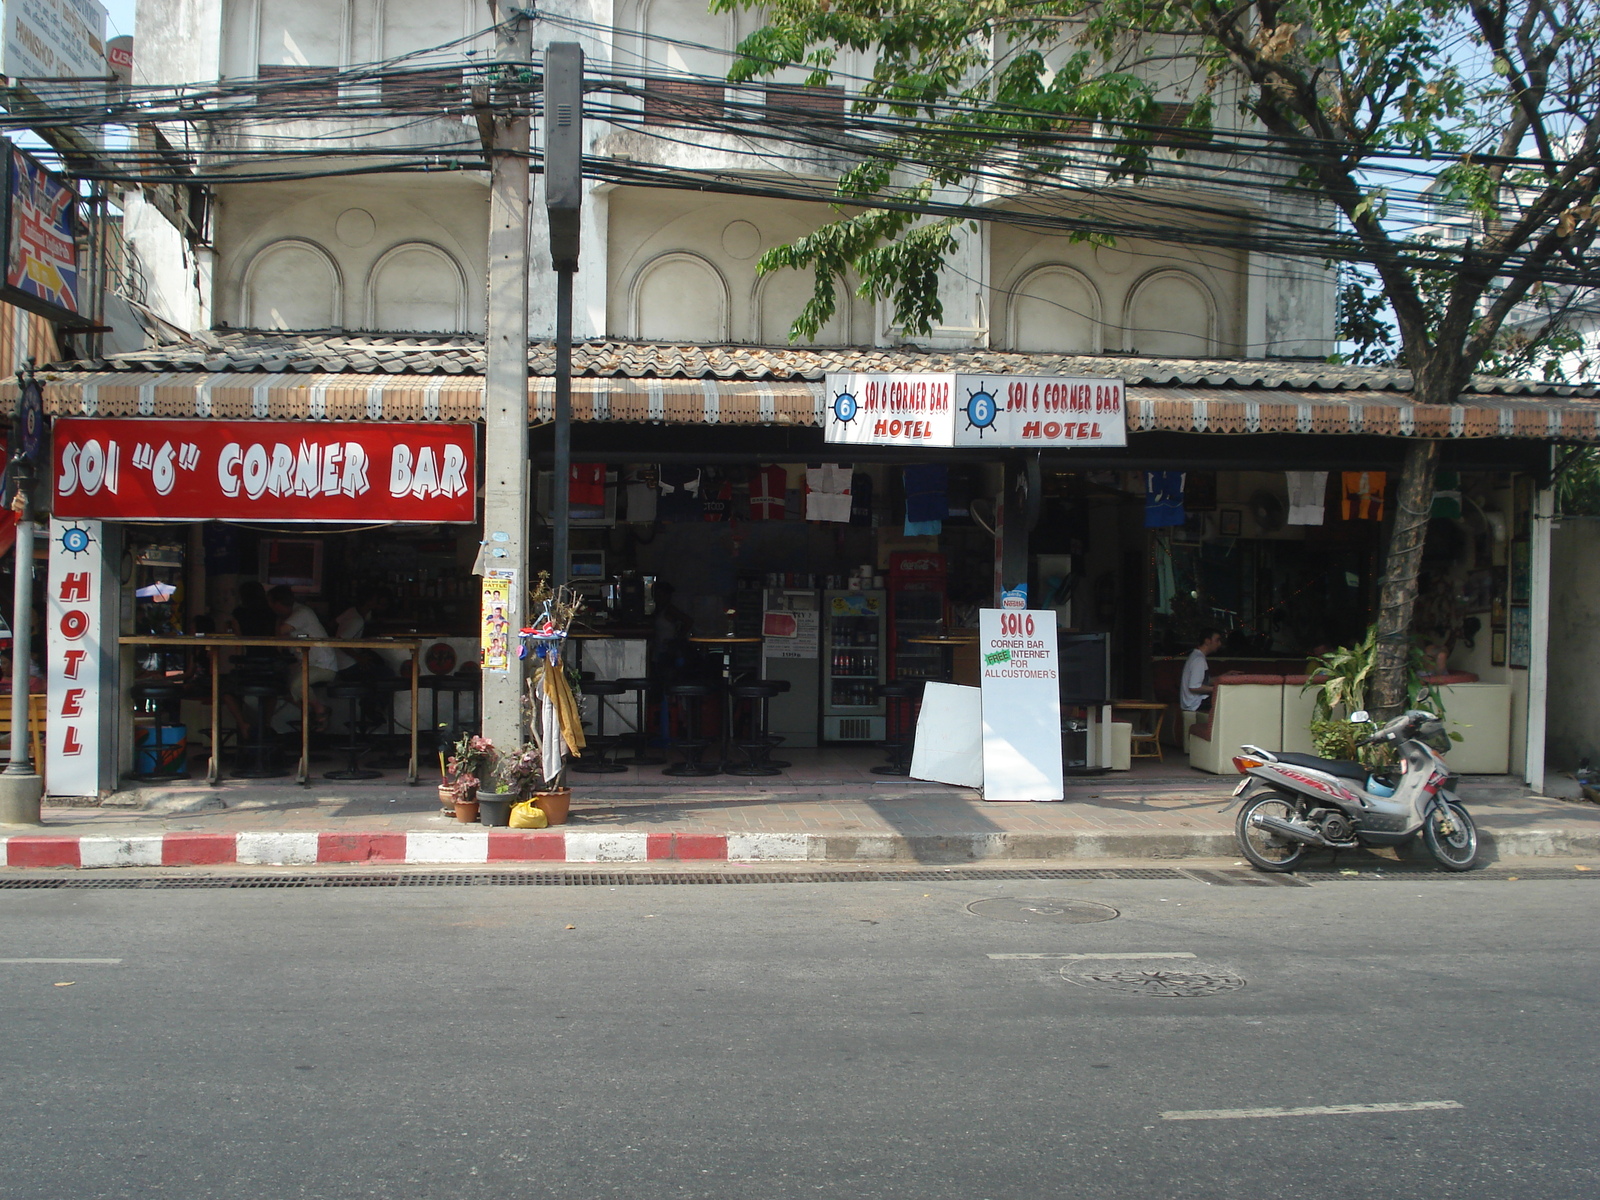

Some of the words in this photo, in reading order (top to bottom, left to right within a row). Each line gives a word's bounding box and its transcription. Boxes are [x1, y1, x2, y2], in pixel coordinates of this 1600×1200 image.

[840, 400, 850, 416] 6
[865, 381, 880, 414] SOI
[881, 382, 889, 413] 6
[889, 381, 928, 415] CORNER
[930, 382, 949, 414] BAR
[1007, 381, 1029, 414] SOI
[1031, 382, 1040, 413] 6
[1043, 382, 1092, 415] CORNER
[1096, 385, 1121, 415] BAR
[975, 399, 989, 420] 6
[874, 419, 932, 440] HOTEL
[1022, 420, 1103, 440] HOTEL
[58, 439, 119, 497] SOI
[217, 438, 370, 501] CORNER
[389, 443, 468, 501] BAR
[69, 533, 81, 548] 6
[1000, 613, 1024, 638] SOI
[1025, 613, 1036, 638] 6
[990, 640, 1024, 649] CORNER
[1026, 640, 1044, 649] BAR
[59, 571, 91, 757] HOTEL
[987, 650, 1010, 666] FREE
[1011, 650, 1051, 659] INTERNET
[1010, 659, 1028, 668] FOR
[985, 669, 1001, 678] ALL
